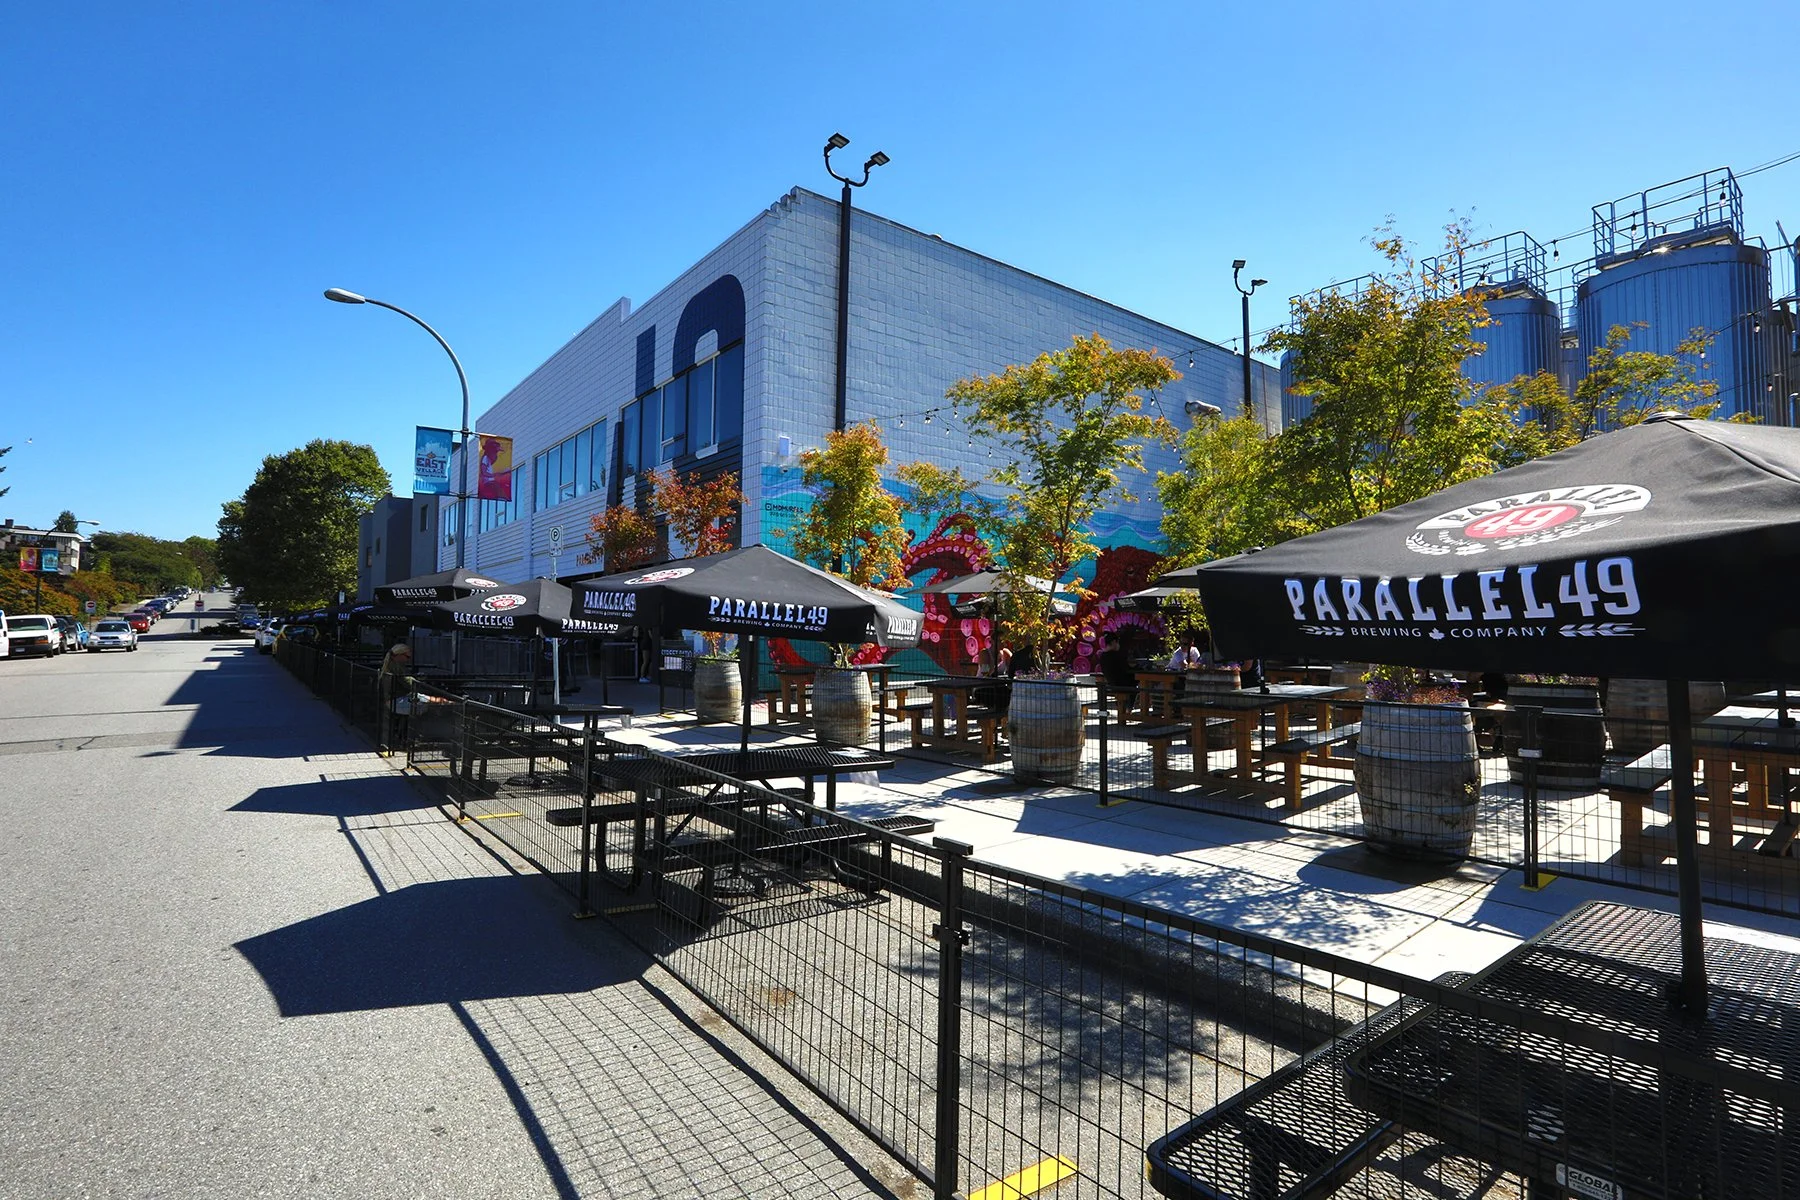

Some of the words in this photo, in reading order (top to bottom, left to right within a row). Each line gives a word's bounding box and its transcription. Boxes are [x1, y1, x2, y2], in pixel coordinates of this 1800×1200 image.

[416, 457, 447, 470] EAST
[1439, 486, 1642, 521] PARALLEL
[1472, 504, 1568, 535] 49
[708, 595, 829, 626] PARALLEL49
[733, 618, 763, 627] BREWING
[771, 621, 802, 630] COMPANY
[1350, 626, 1422, 638] BREWING
[1450, 625, 1548, 638] COMPANY
